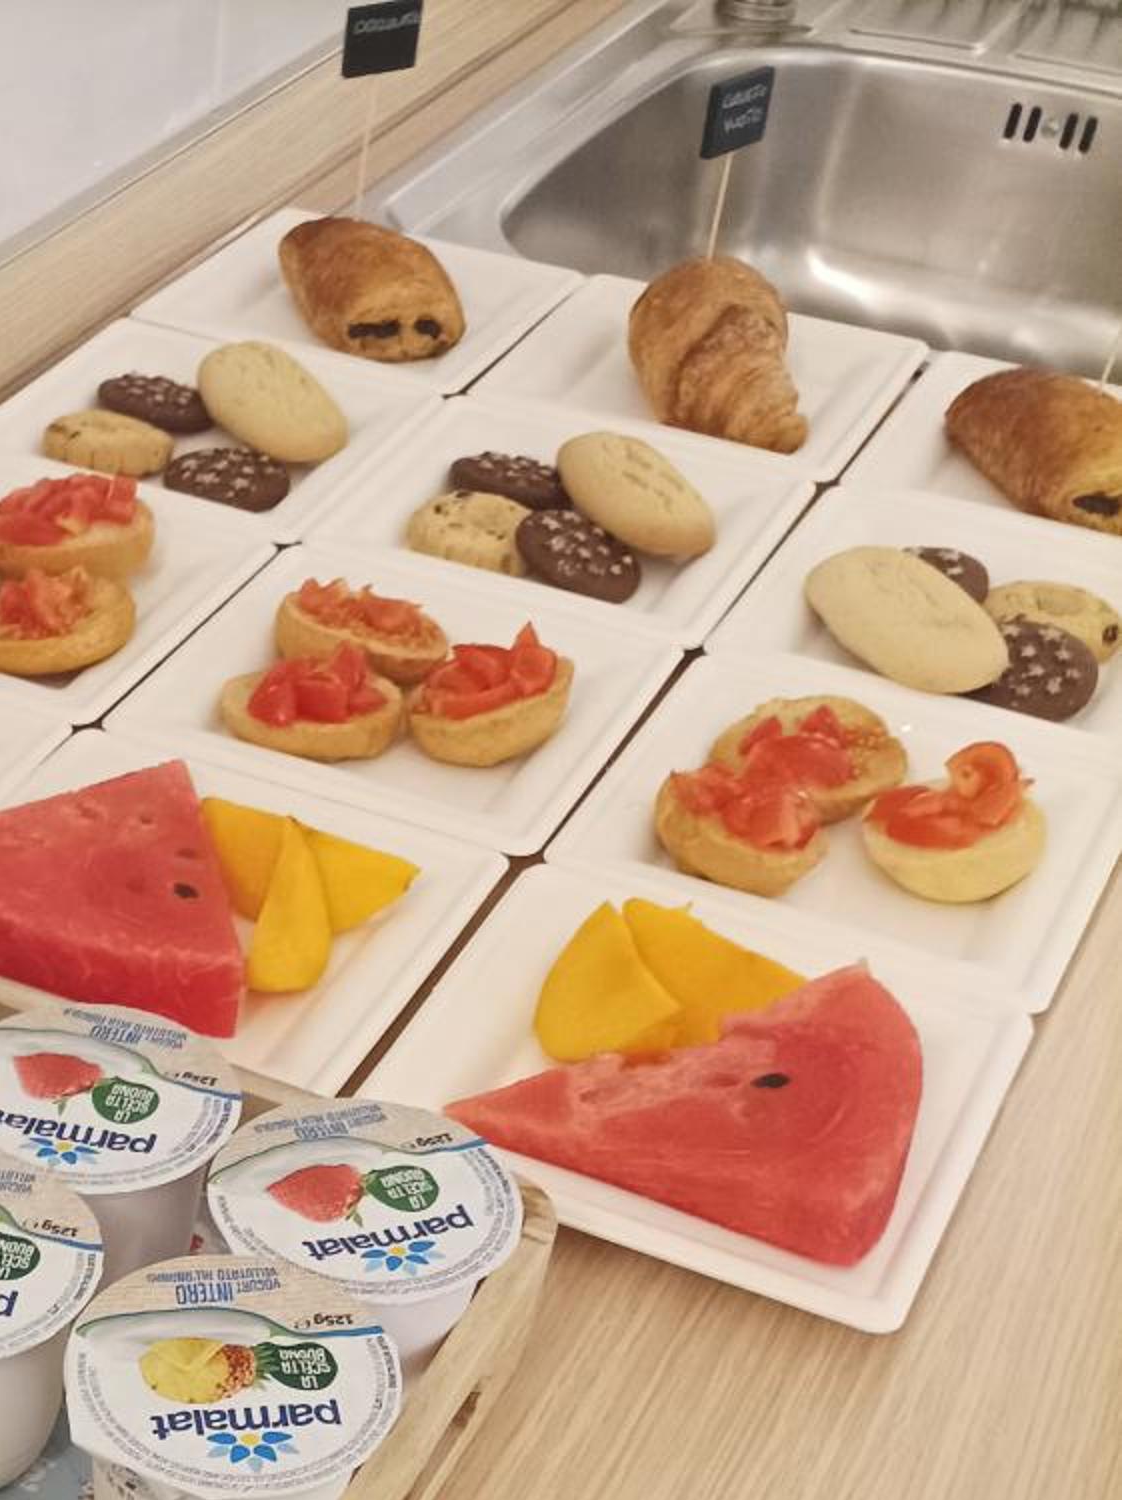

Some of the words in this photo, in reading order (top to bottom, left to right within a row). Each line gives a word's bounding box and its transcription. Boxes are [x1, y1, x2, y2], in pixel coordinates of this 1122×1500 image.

[111, 1084, 154, 1100] BUONA
[106, 1095, 151, 1113] SCELTA
[114, 1111, 130, 1122] LA
[41, 1219, 77, 1237] 125g
[303, 1204, 474, 1261] parmalat
[175, 1282, 233, 1304] INTERO
[314, 1313, 354, 1325] 125g
[279, 1347, 326, 1360] BUONA
[281, 1360, 332, 1375] SCELTA
[301, 1375, 318, 1389] LA
[150, 1399, 341, 1440] parmalat
